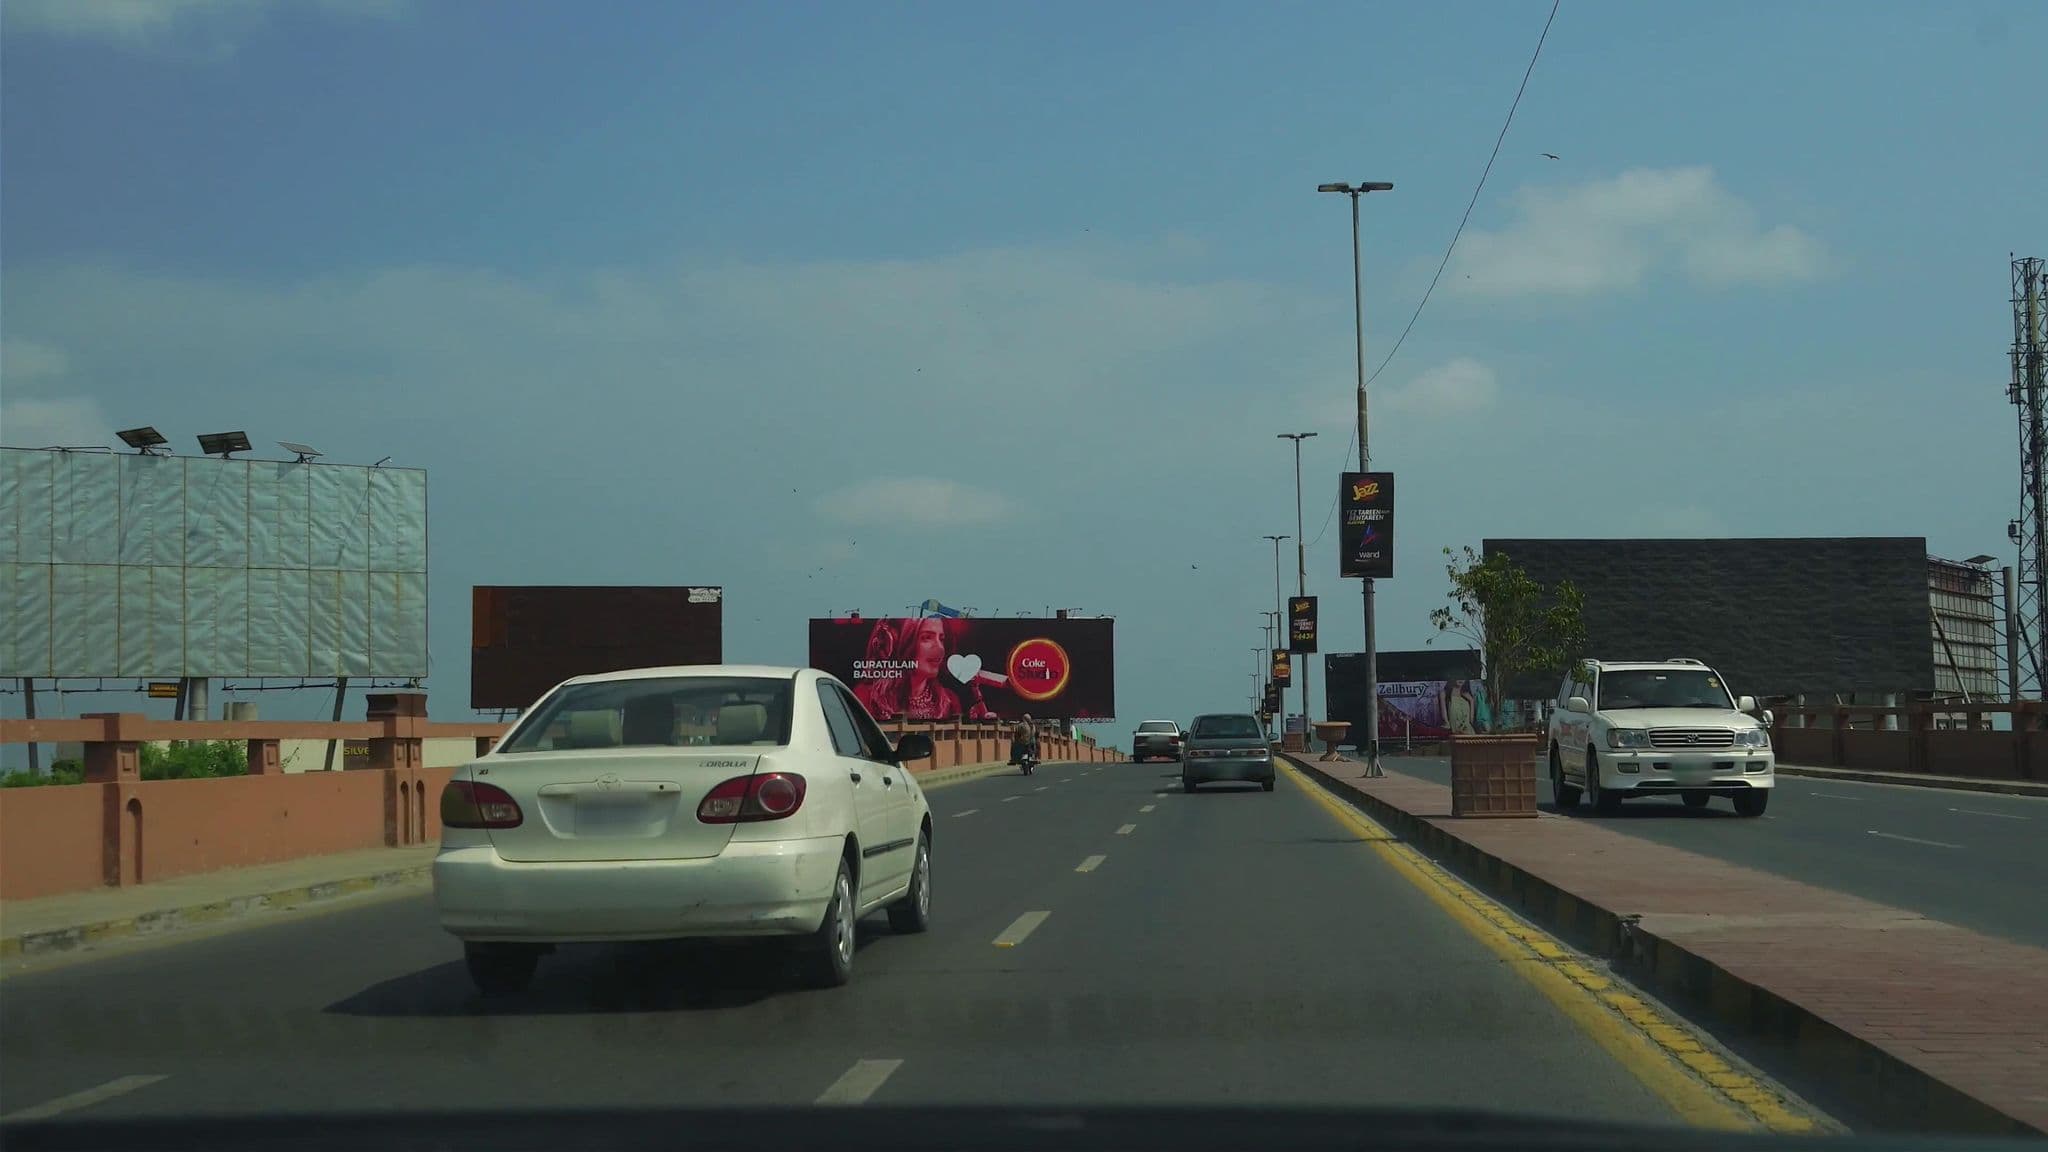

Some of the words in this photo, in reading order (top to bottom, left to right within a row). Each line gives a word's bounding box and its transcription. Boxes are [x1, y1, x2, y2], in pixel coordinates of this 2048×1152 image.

[1352, 482, 1379, 501] Jazz
[1358, 549, 1380, 558] wand
[853, 660, 919, 669] QURATULAIN
[1022, 657, 1046, 668] Coke
[853, 670, 903, 679] BALOUCH
[1378, 682, 1427, 698] Zellbury
